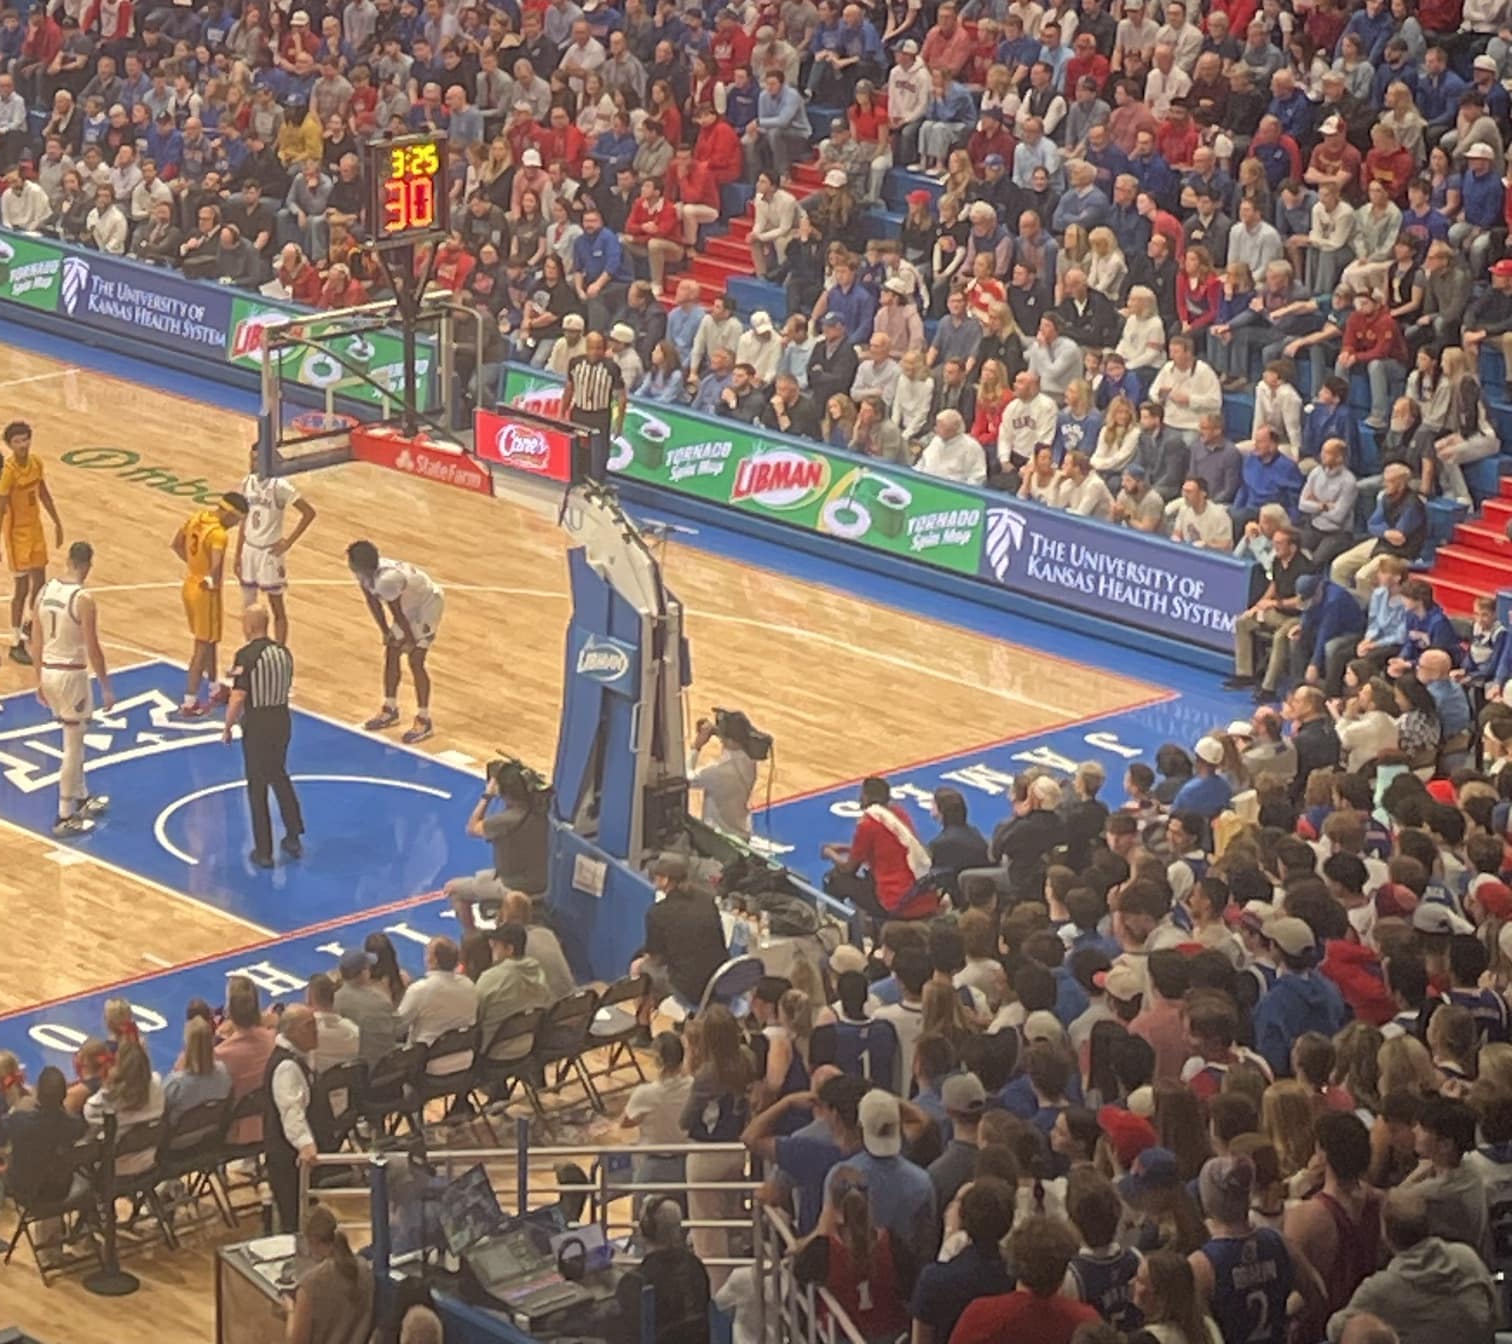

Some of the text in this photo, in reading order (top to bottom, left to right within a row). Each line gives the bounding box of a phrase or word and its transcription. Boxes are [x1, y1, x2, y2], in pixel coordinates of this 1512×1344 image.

[392, 143, 439, 179] 3:25
[384, 177, 433, 232] 30
[91, 274, 206, 323] THE UNIVERSITY OF
[89, 293, 134, 323] KANSAS
[135, 305, 182, 336] HEALTH
[183, 317, 226, 347] SYSTEM
[666, 441, 733, 468] TORNADO
[734, 456, 823, 500] LIBMAN
[908, 509, 979, 536] TORNADO
[911, 523, 973, 550] Spin Mop
[1030, 533, 1206, 600] THE UNIVERSITY OF
[1028, 555, 1238, 634] KANSAS HEALTH SYSTEM
[857, 1049, 872, 1081] 1
[857, 1281, 873, 1311] 1
